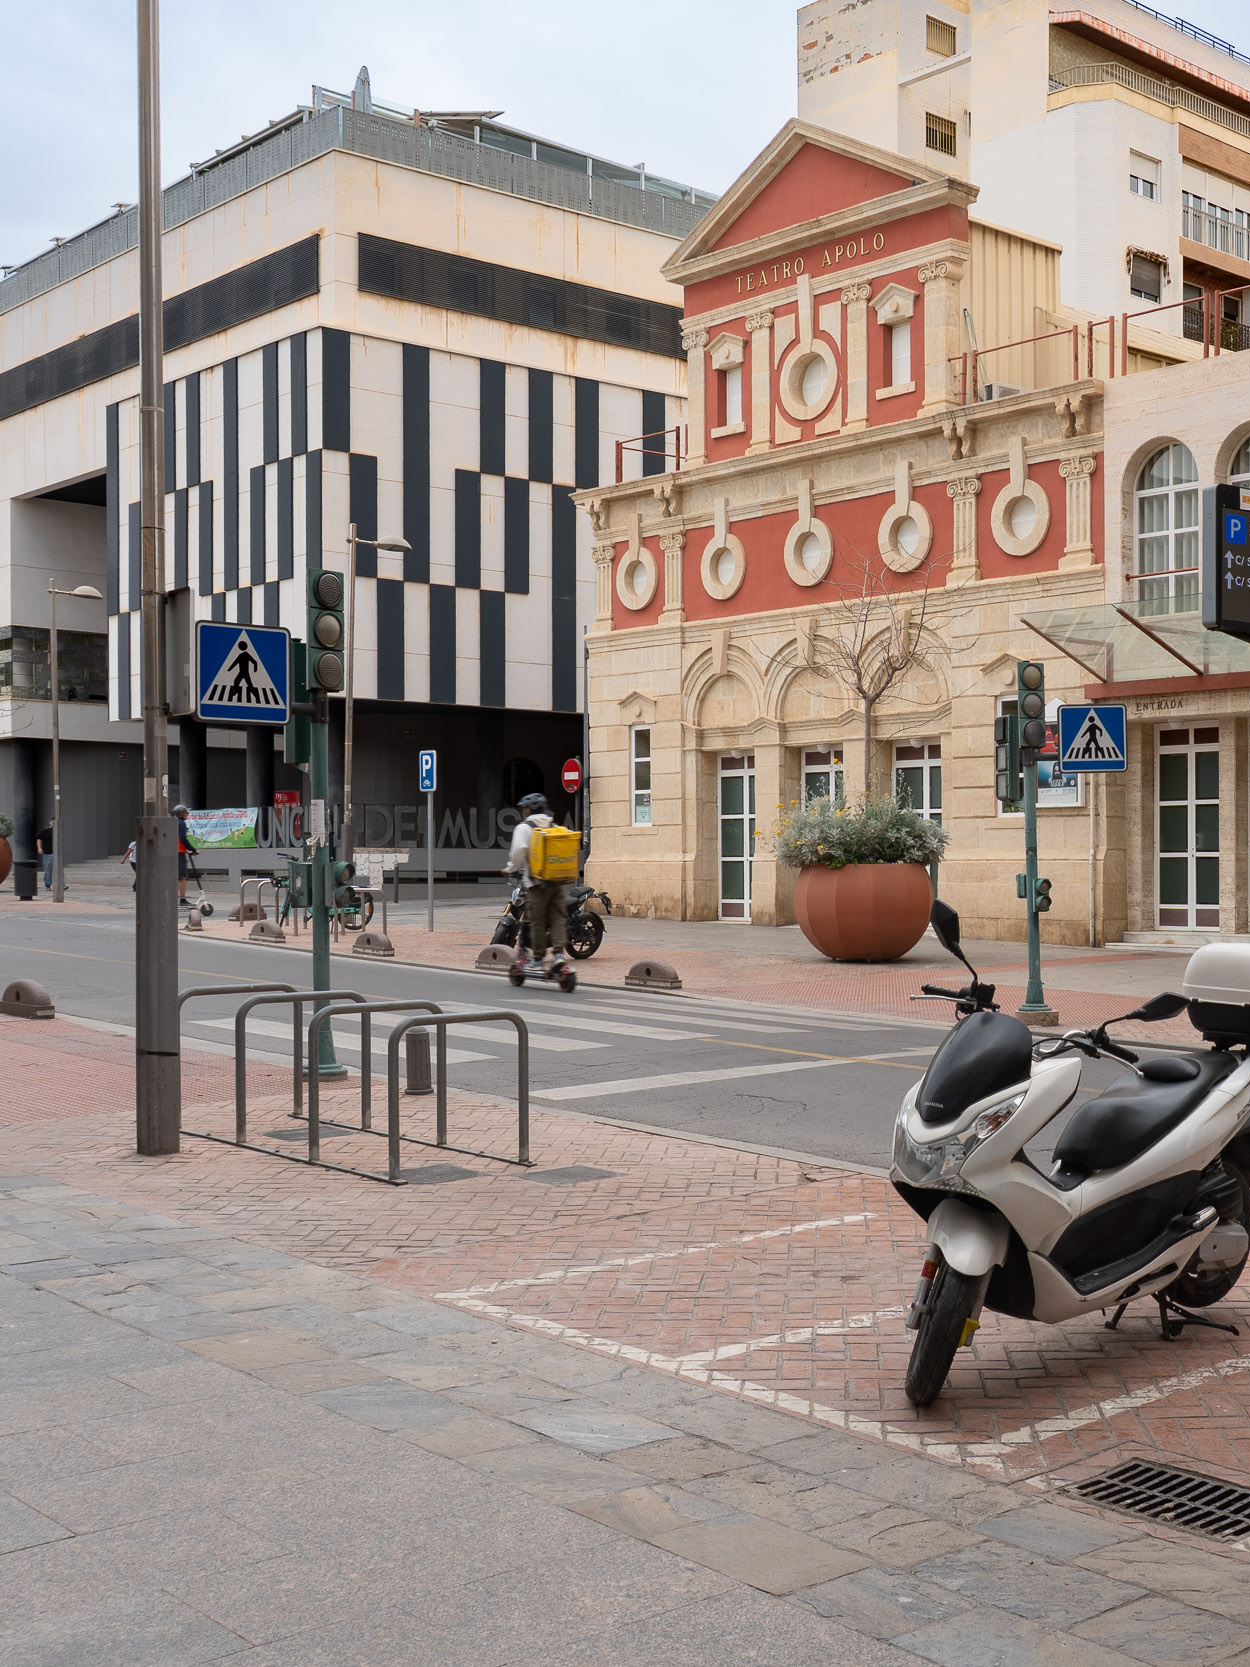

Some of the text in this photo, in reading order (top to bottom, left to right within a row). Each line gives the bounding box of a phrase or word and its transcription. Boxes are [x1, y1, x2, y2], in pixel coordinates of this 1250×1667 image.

[735, 232, 885, 294] TEATRO APOLO
[1231, 518, 1242, 539] P
[1235, 555, 1245, 567] C/
[1235, 576, 1245, 587] C/
[1135, 699, 1184, 712] ENTRADA
[422, 755, 432, 777] P
